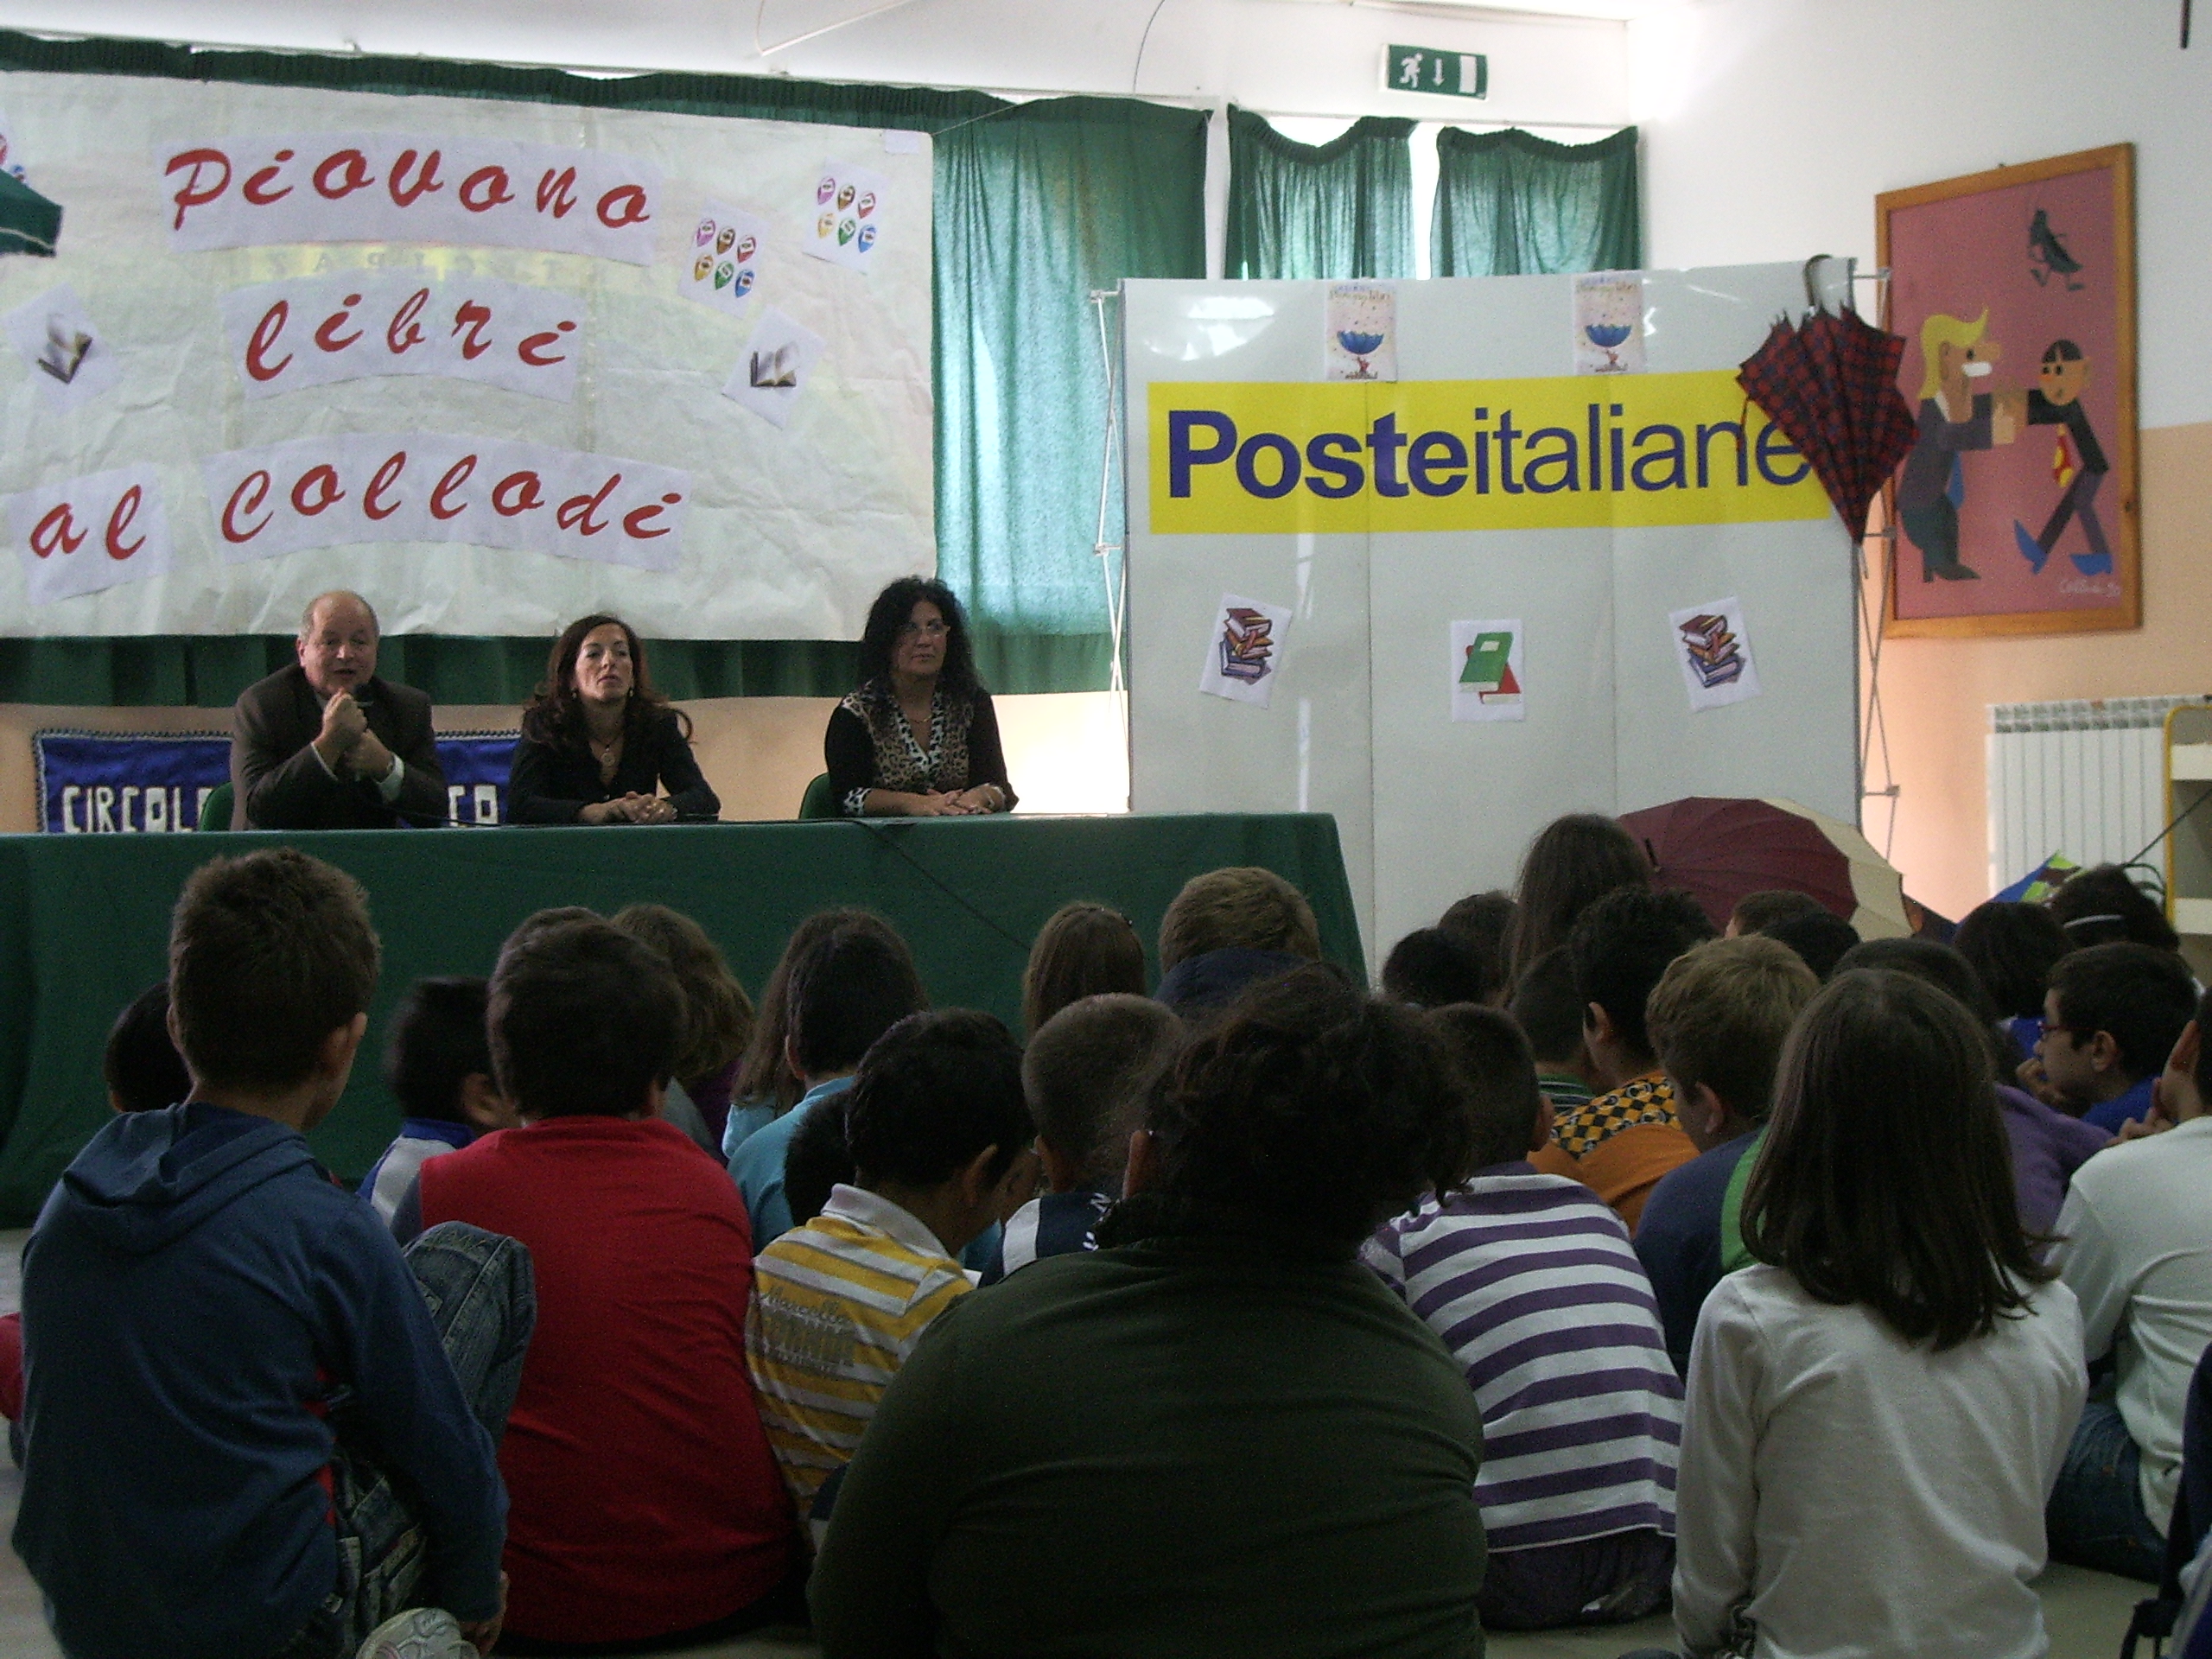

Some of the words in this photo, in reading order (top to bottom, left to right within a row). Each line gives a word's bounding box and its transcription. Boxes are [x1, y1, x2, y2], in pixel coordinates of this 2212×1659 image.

[165, 148, 652, 231] Piovono
[245, 288, 578, 382] libri
[1168, 403, 1812, 499] Posteitaliane
[29, 485, 146, 562] al
[221, 451, 683, 545] Collodi
